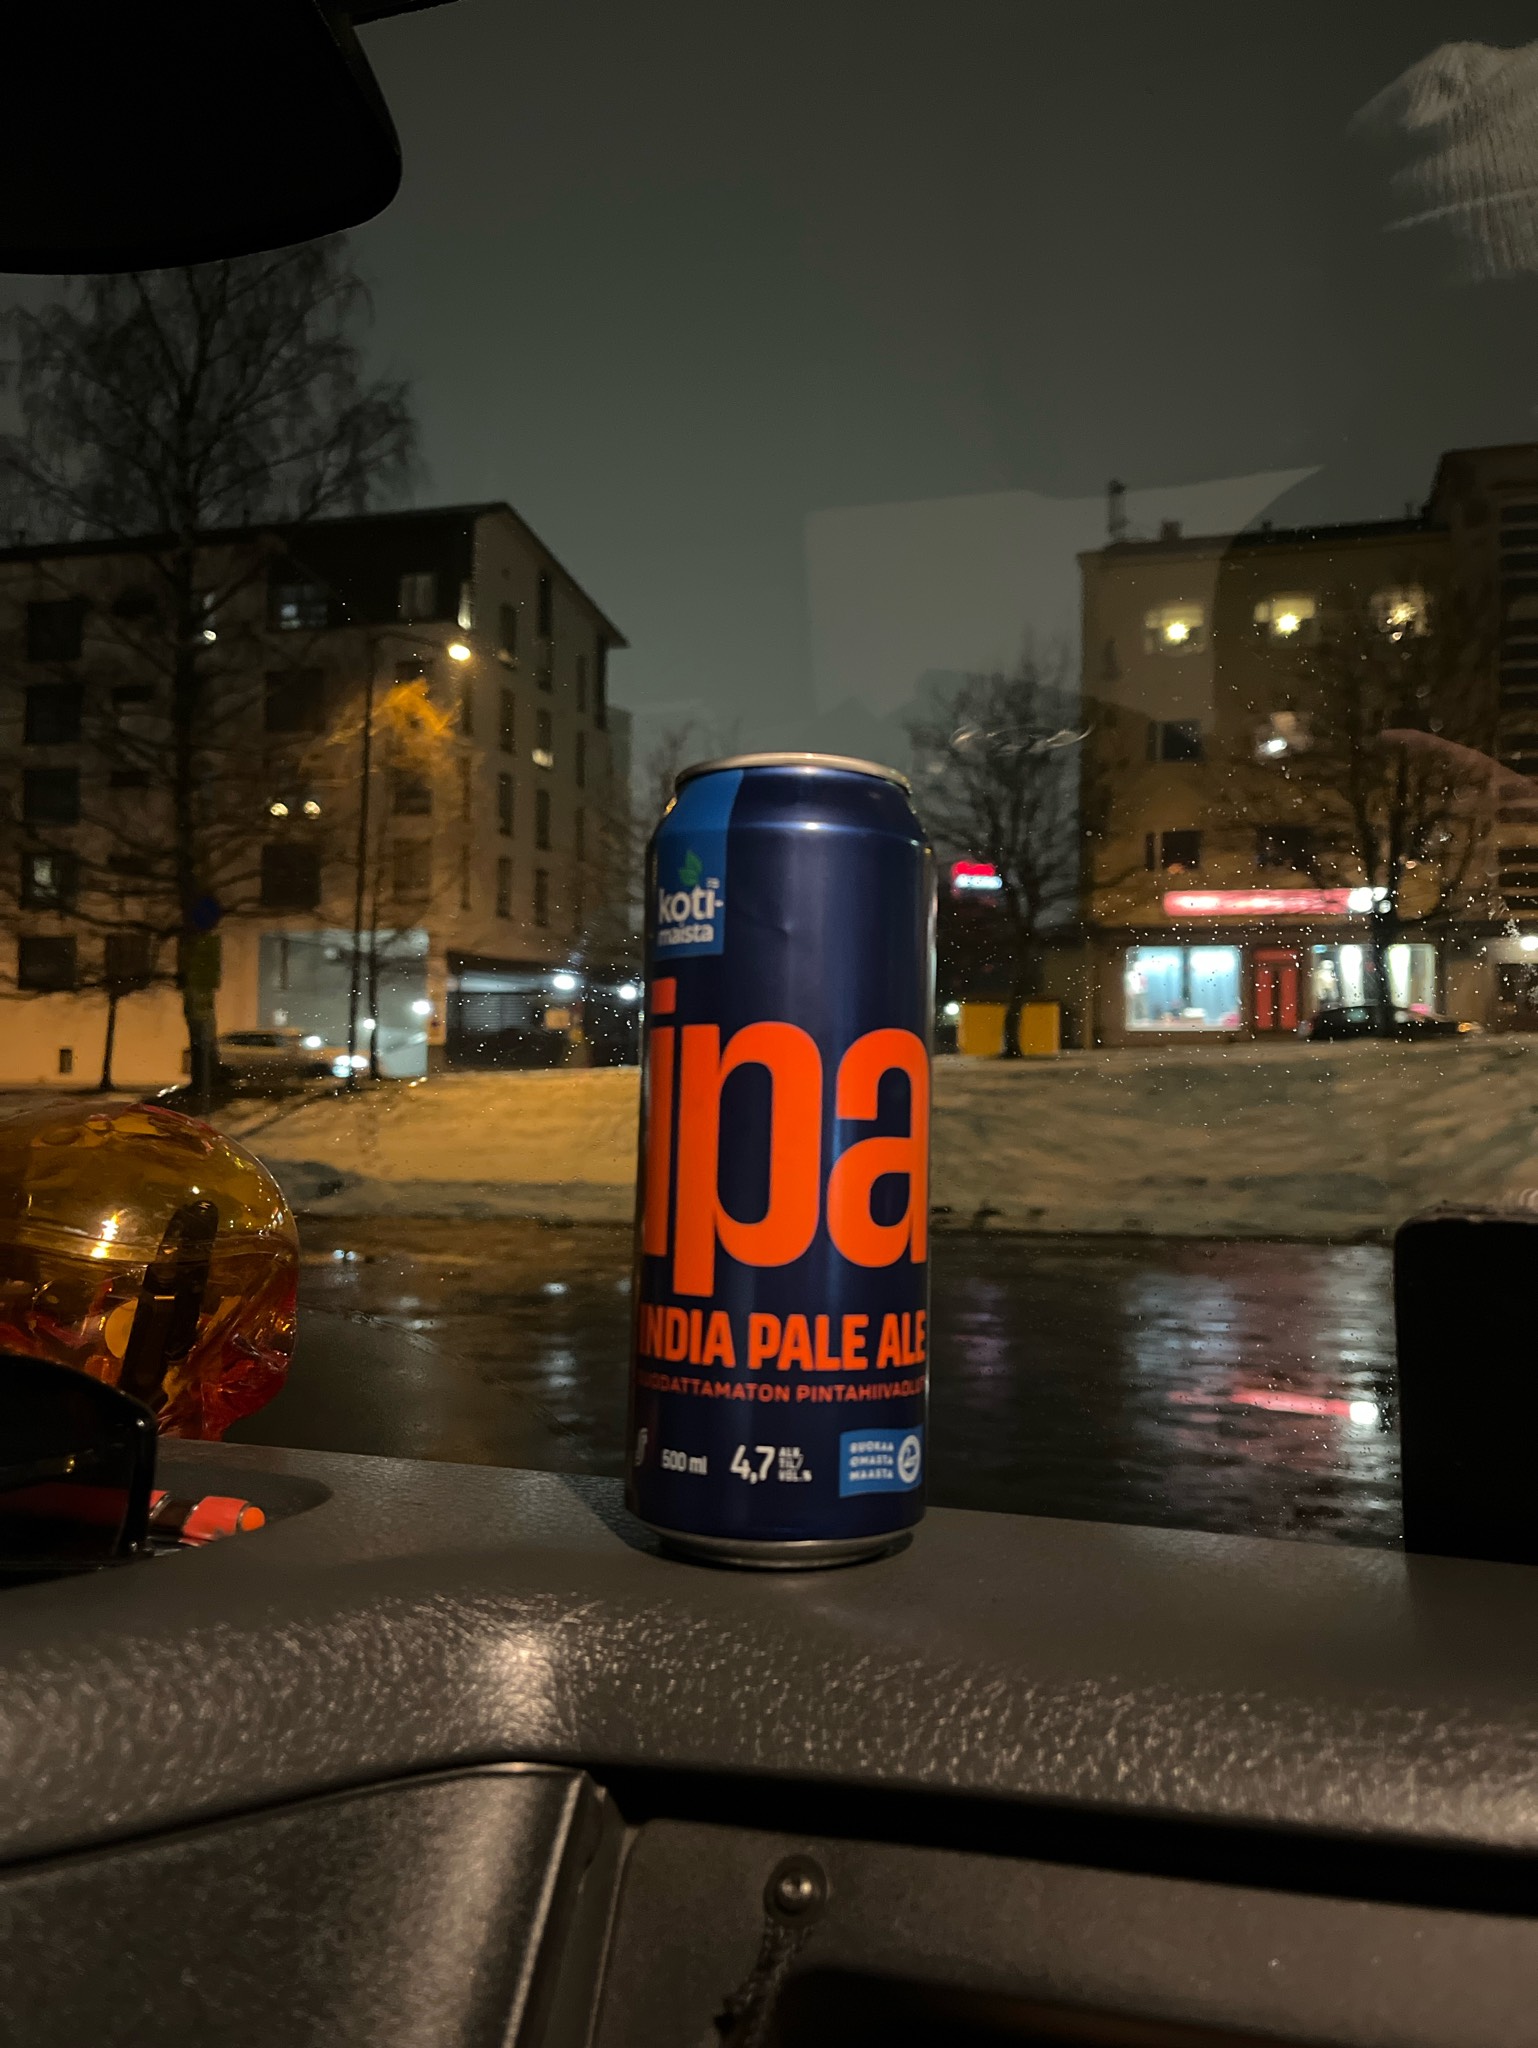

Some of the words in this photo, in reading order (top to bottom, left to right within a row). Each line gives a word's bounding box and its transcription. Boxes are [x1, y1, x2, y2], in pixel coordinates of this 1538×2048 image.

[657, 923, 714, 947] maista
[643, 976, 930, 1298] ipa
[747, 1312, 869, 1371] PALE
[876, 1309, 926, 1369] ALE
[661, 1449, 686, 1473] 500
[689, 1454, 708, 1476] ml
[730, 1444, 775, 1485] 4,7
